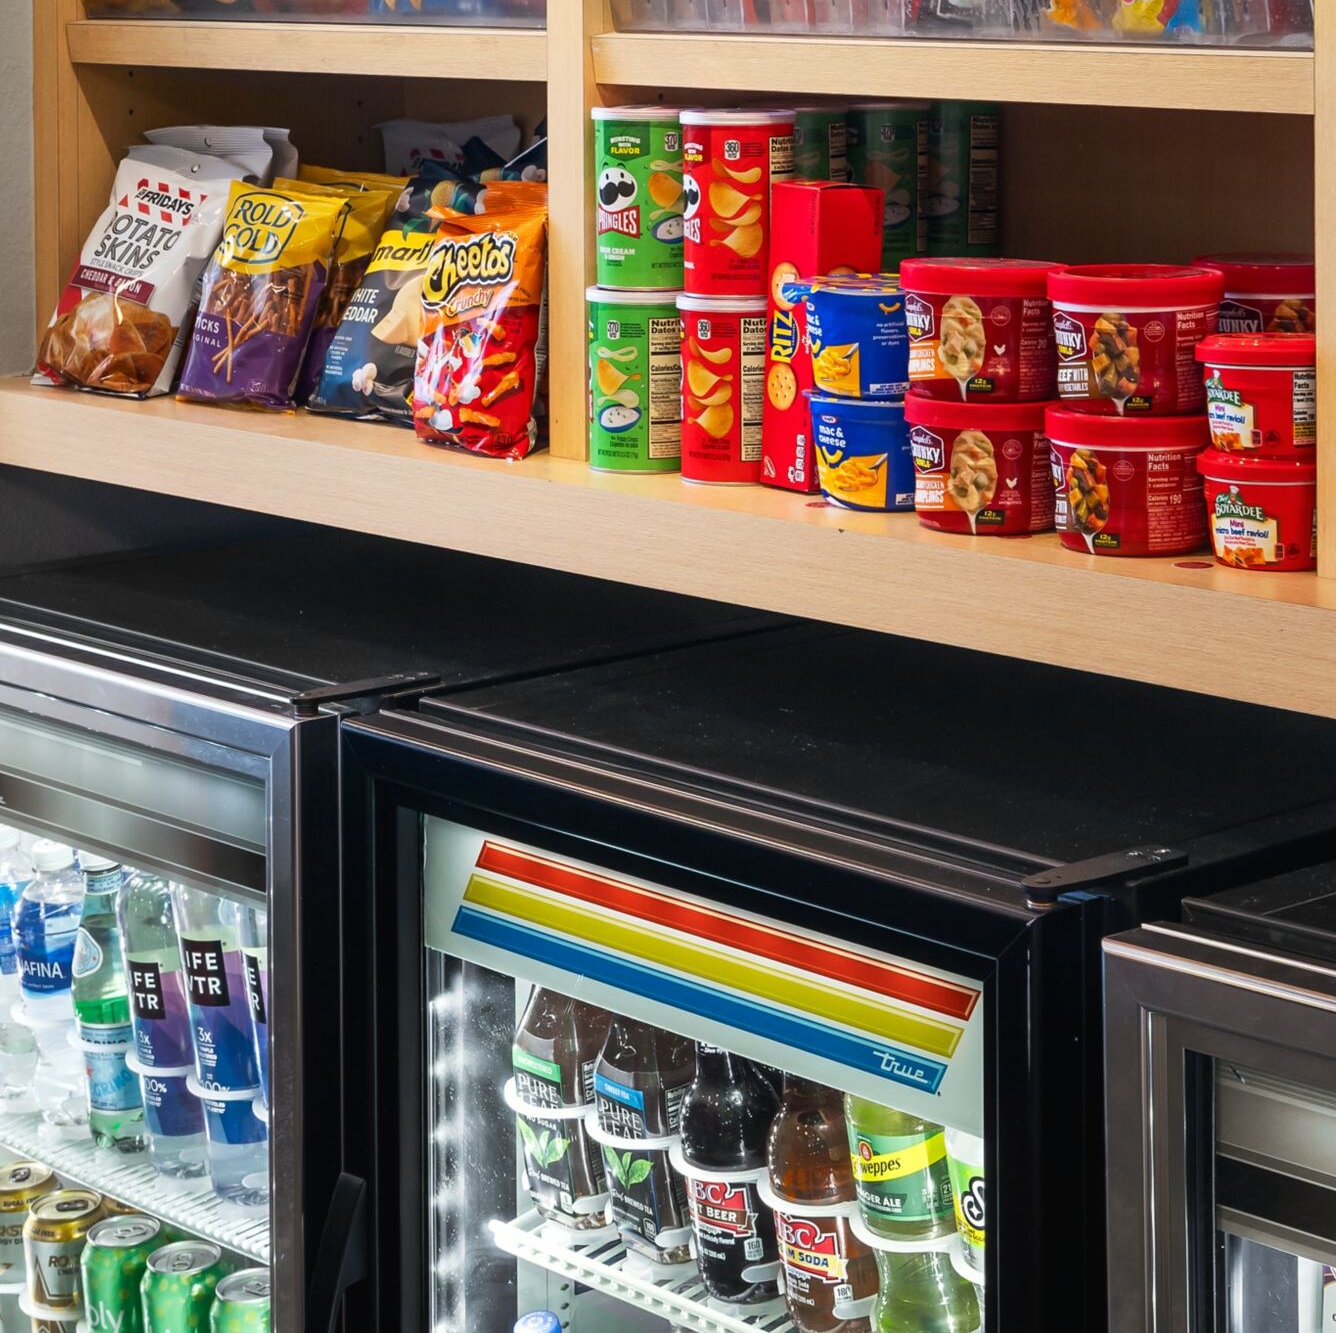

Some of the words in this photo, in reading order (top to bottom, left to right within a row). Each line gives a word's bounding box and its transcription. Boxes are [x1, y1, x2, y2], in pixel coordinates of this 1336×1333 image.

[610, 146, 641, 155] FLAVOR
[725, 141, 739, 154] 360
[141, 190, 194, 215] FRIDAYS
[233, 199, 293, 228] ROLD
[224, 223, 281, 255] GOLD
[94, 234, 160, 270] SKINS
[80, 269, 108, 283] CHEDDAR
[422, 232, 512, 304] Cheetos
[350, 288, 379, 304] HITE
[446, 288, 493, 317] Crunchy
[343, 306, 379, 324] EDDAR
[1177, 311, 1205, 322] Nutrition
[607, 321, 619, 333] 370
[651, 326, 675, 334] Datos
[1177, 321, 1196, 330] Facts
[770, 309, 794, 364] RITZ
[1226, 415, 1246, 425] ravioli
[818, 424, 835, 437] mac
[836, 427, 844, 438] &
[818, 434, 846, 448] cheese
[1148, 454, 1182, 462] Nutrition
[1148, 462, 1170, 471] Facts
[1169, 493, 1182, 505] 190
[1215, 502, 1264, 521] BOYARDEE
[1230, 519, 1245, 528] Mini
[1231, 527, 1246, 537] beef
[1246, 529, 1270, 539] ravioli
[184, 951, 218, 970] IFE
[198, 1026, 213, 1043] 3x
[875, 1051, 929, 1084] true
[518, 1073, 559, 1104] PURE
[604, 1083, 620, 1097] SWEET
[620, 1091, 630, 1100] TEA
[600, 1097, 643, 1131] PURE
[560, 1183, 570, 1192] TEA
[693, 1180, 722, 1205] BC
[625, 1195, 644, 1212] BREWED
[644, 1205, 653, 1216] TEA
[882, 1196, 902, 1207] ALE
[706, 1205, 737, 1223] BEER
[782, 1223, 812, 1249] BC
[747, 1241, 760, 1250] 160
[798, 1252, 829, 1268] SODA
